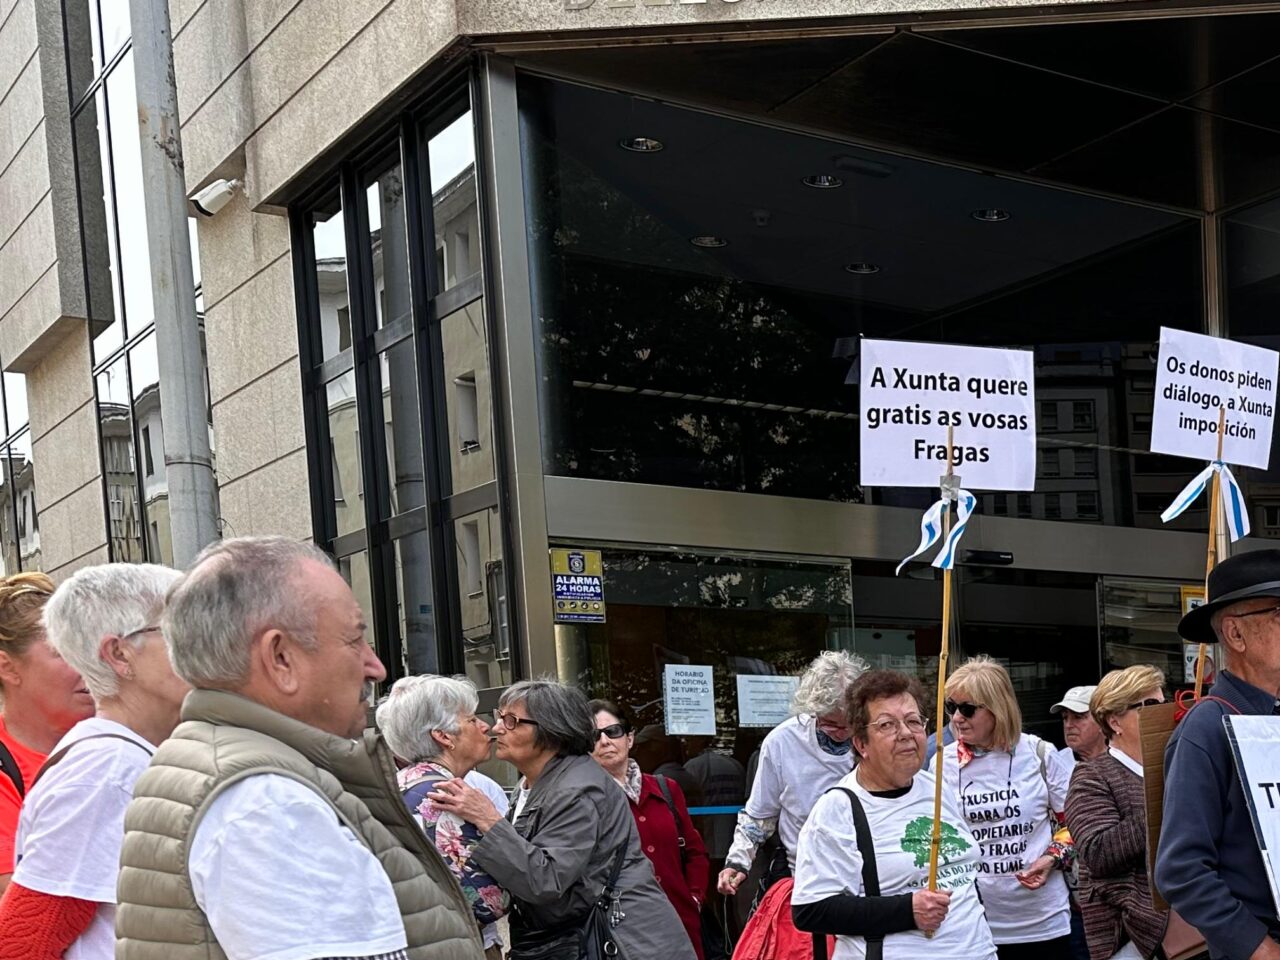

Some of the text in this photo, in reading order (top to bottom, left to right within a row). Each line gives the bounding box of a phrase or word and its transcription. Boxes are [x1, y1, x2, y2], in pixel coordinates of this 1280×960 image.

[870, 367, 1028, 399] A Xunta quere
[1166, 356, 1272, 391] Os donos piden
[1163, 383, 1273, 417] diálogo, a Xunta
[867, 404, 1028, 430] gratis as vosas
[1179, 412, 1256, 440] impoición
[914, 439, 990, 466] Fragas
[555, 584, 601, 593] 24 HORAS
[556, 576, 601, 585] ALARMA
[966, 789, 1020, 806] XUSTICIA
[969, 805, 1021, 823] PARA OS
[971, 821, 1034, 841] OPIETARI@S
[993, 859, 1025, 875] EUME
